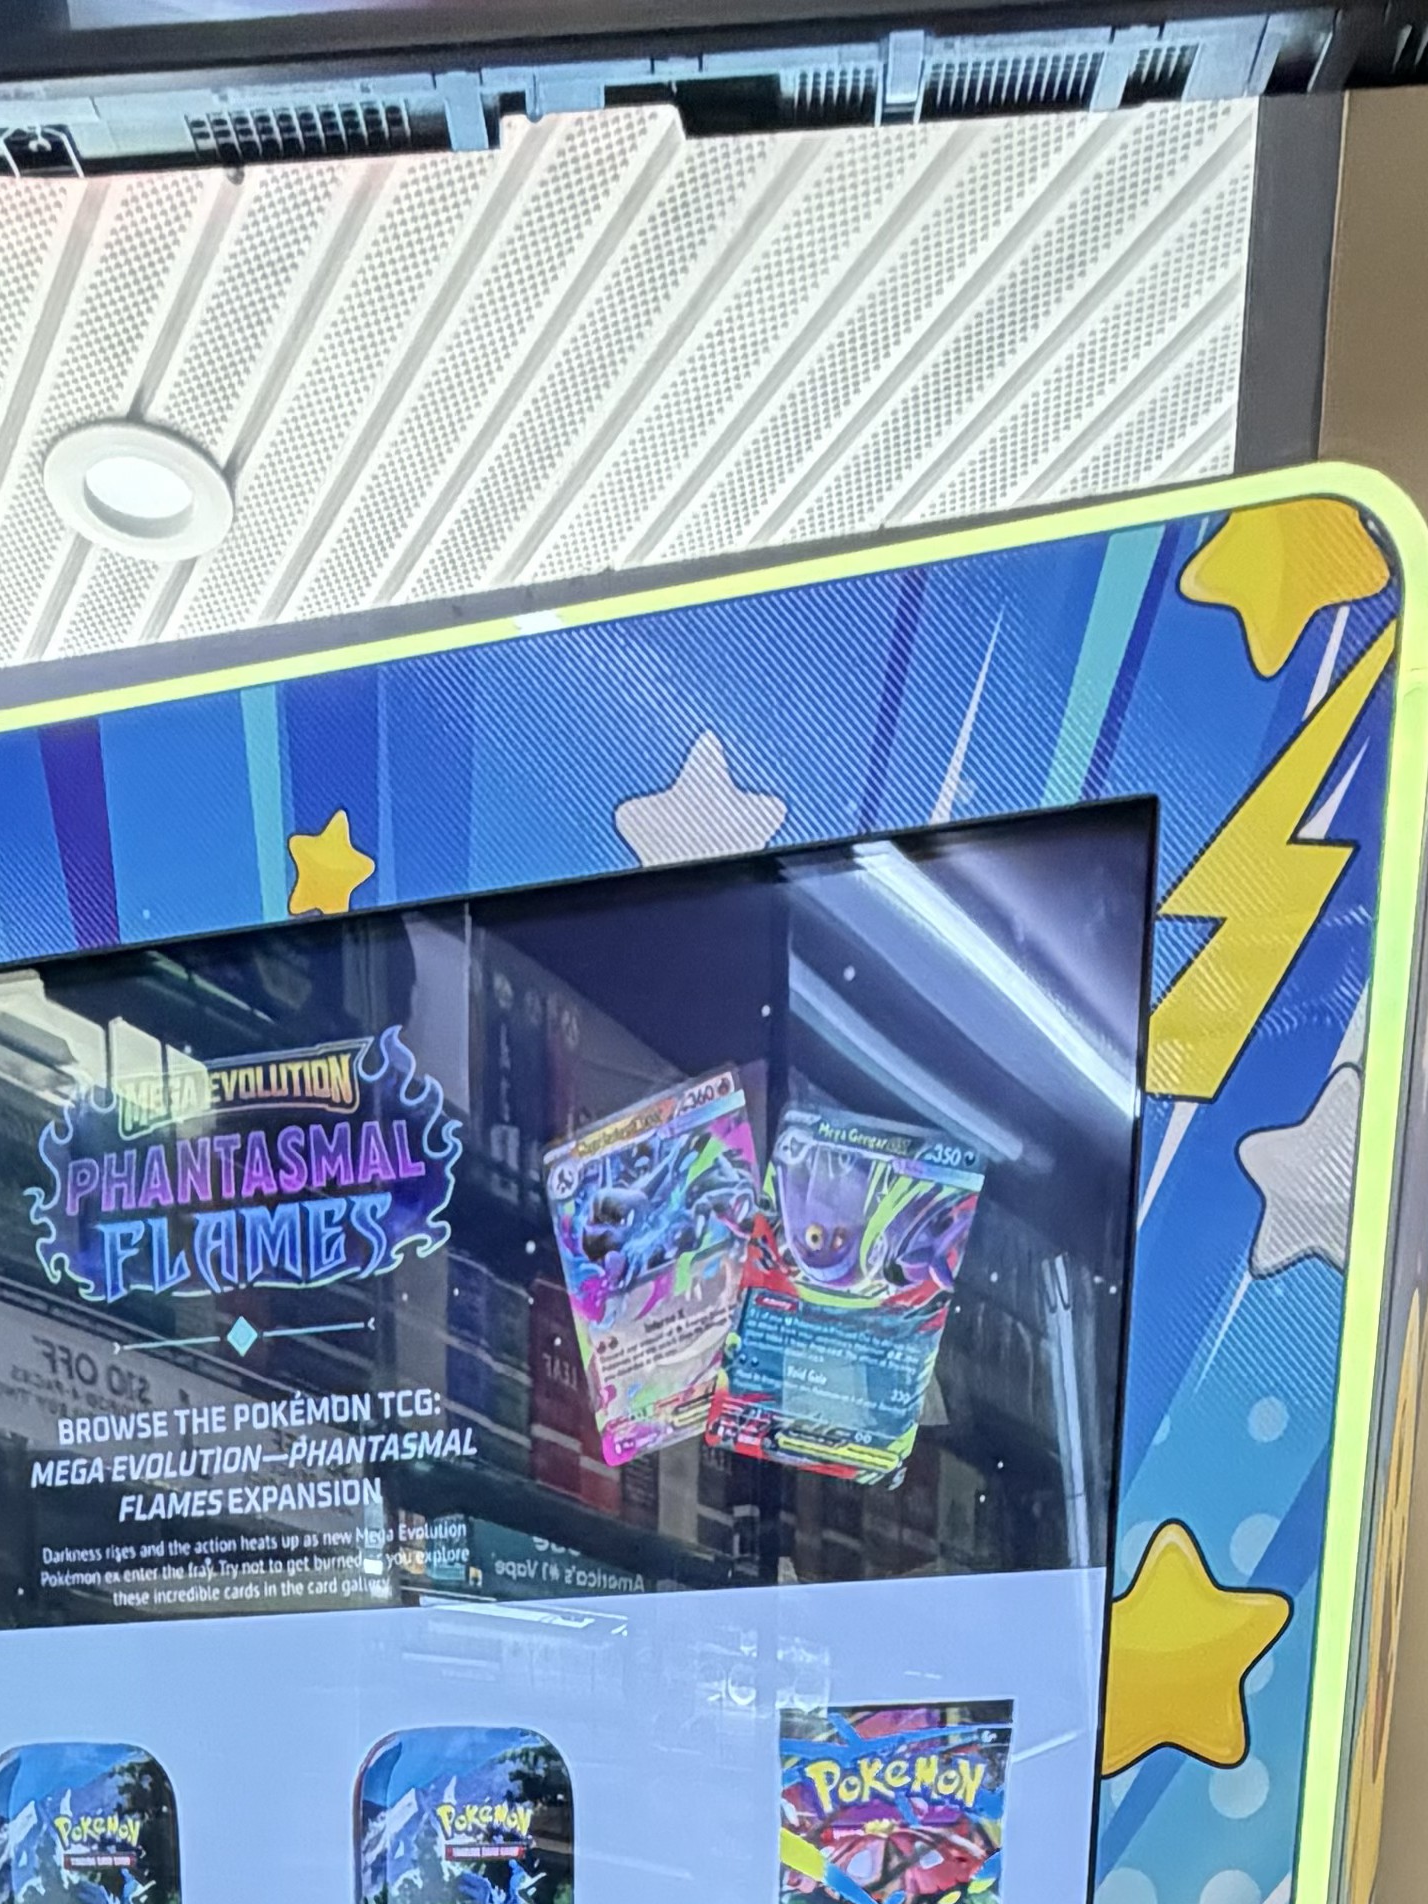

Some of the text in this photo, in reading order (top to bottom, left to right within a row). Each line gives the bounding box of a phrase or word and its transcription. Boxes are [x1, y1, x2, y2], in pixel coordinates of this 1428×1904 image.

[209, 1053, 353, 1104] EVOLUTION
[66, 1120, 425, 1216] PHANTASMAL
[98, 1193, 392, 1302] FLAMES
[59, 1389, 440, 1445] BROWSE THE POKÉMON TCG:
[31, 1457, 104, 1488] MEGA
[119, 1478, 383, 1522] FLAMES EXPANSION
[43, 1522, 467, 1564] Darkness and the action heats Evolution
[40, 1567, 102, 1588] Pokémon
[123, 1568, 159, 1582] enter
[313, 1551, 361, 1570] burned
[416, 1546, 470, 1569] explore
[113, 1583, 260, 1605] these incredible cards
